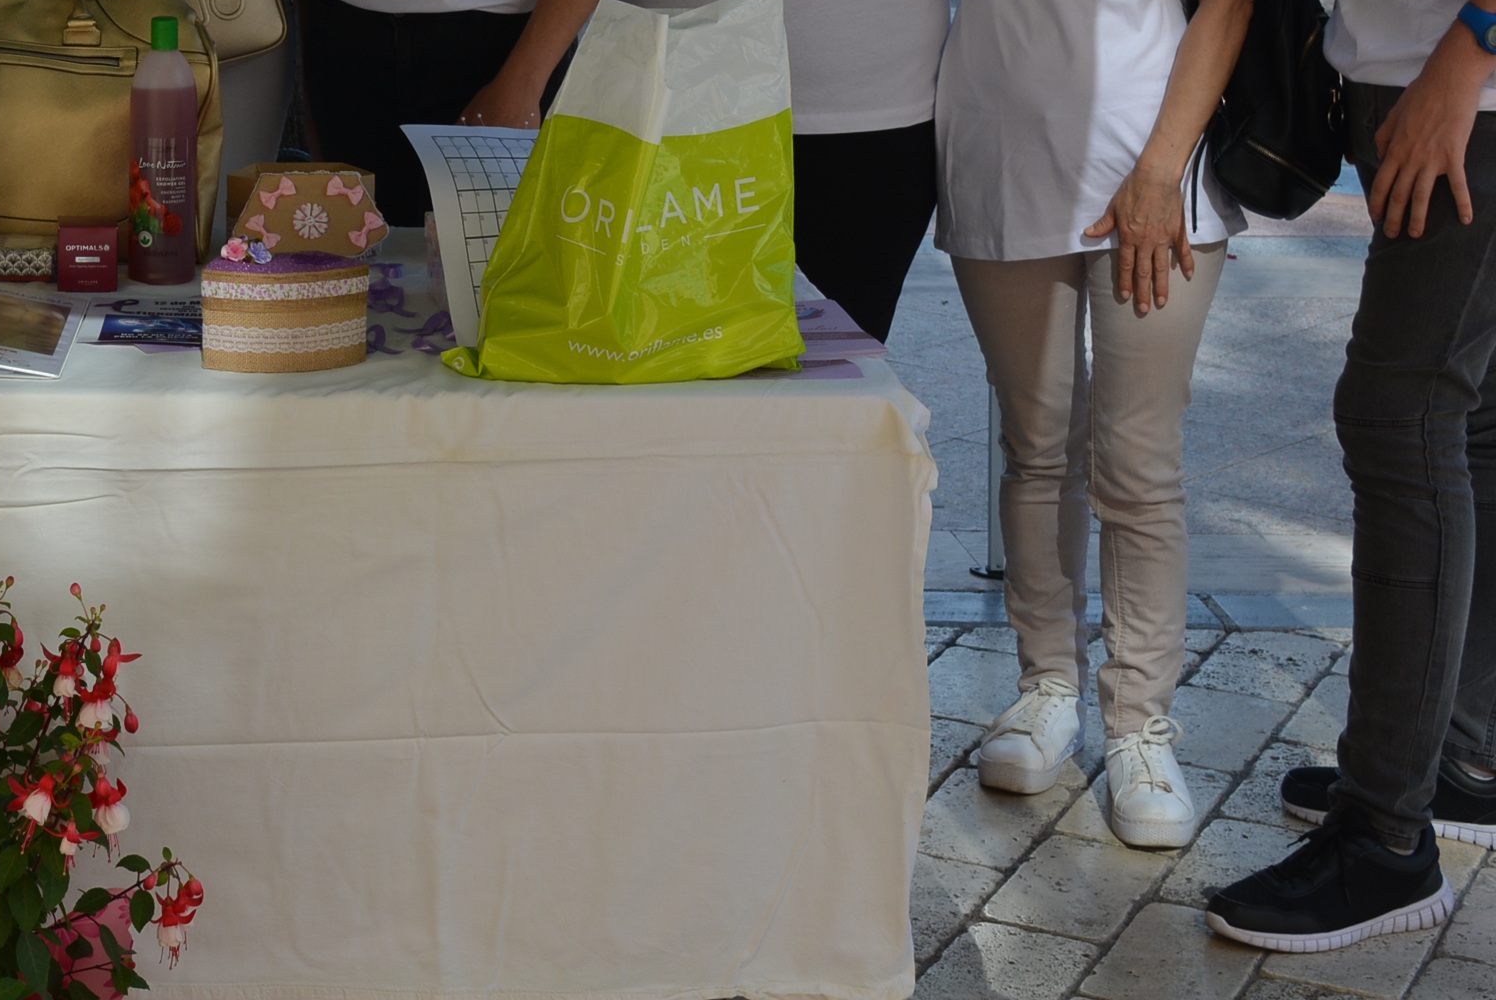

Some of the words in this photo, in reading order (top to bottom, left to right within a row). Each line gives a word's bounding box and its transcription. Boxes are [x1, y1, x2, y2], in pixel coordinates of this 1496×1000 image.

[561, 177, 761, 243] ORIAME
[65, 244, 104, 252] OPTIMALS
[568, 325, 723, 362] www.oriflame.es
